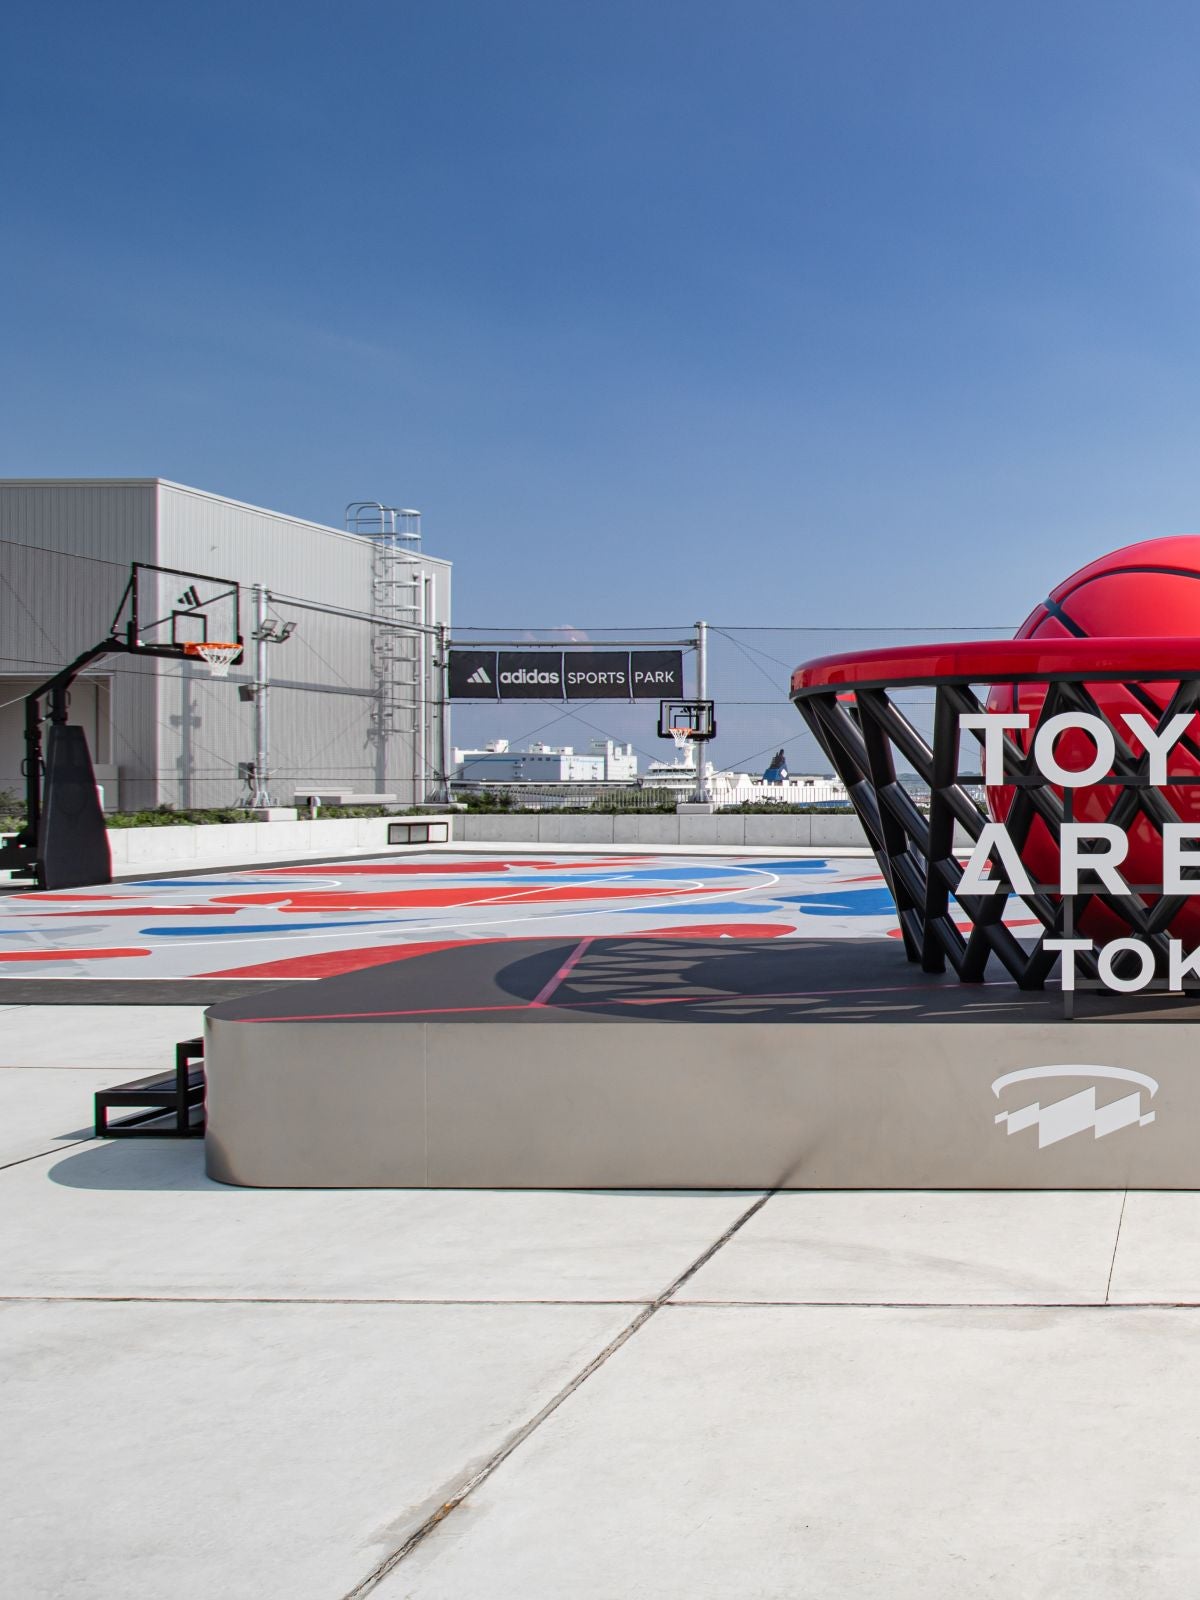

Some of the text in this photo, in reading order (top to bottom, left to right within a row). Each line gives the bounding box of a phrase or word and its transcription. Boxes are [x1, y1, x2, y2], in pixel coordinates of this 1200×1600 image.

[500, 669, 675, 684] adidas SPORTS PARK
